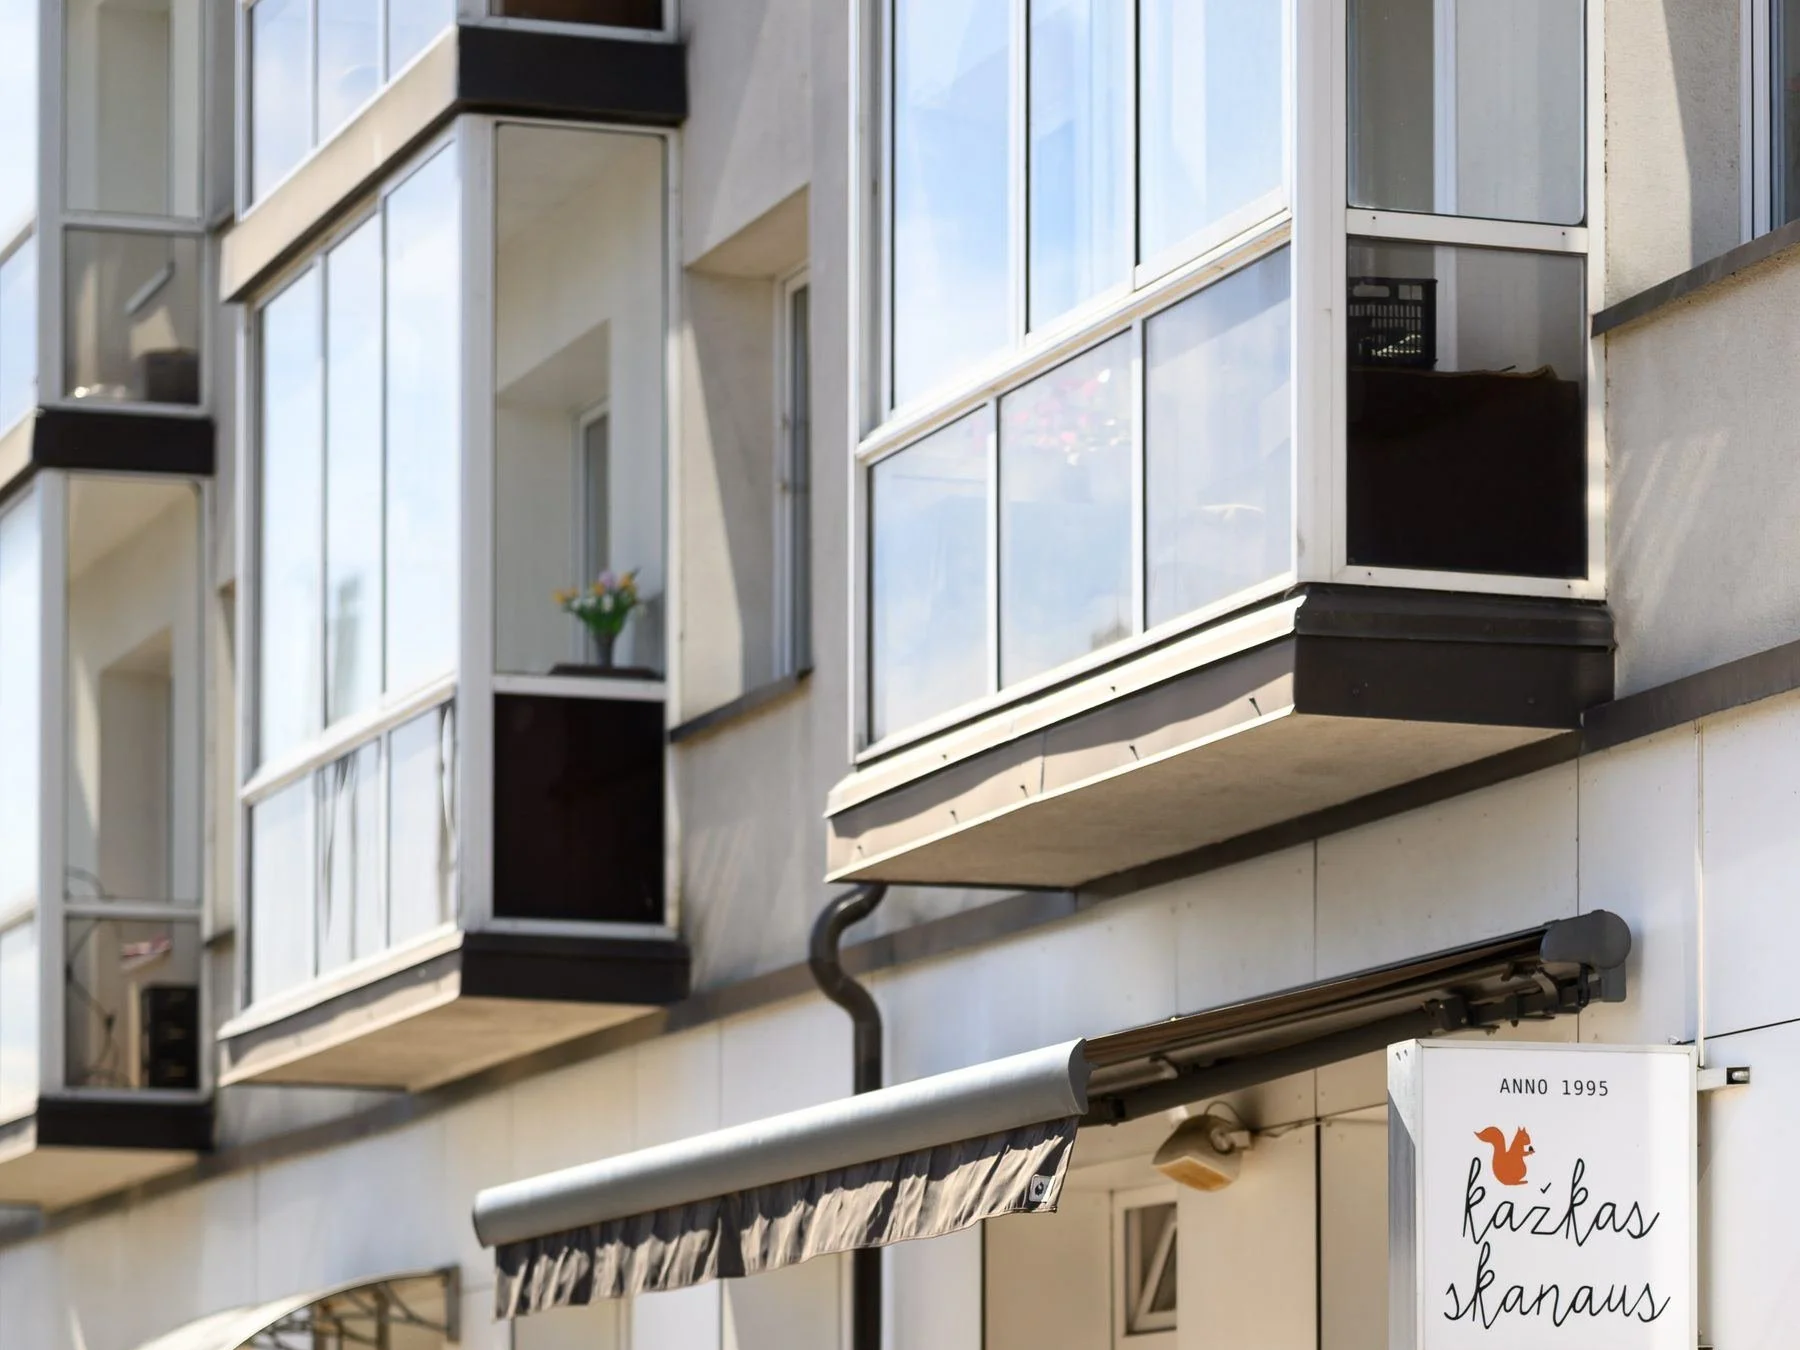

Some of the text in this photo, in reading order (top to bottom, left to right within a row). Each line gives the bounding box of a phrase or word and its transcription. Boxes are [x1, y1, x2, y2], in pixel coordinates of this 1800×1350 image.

[1499, 1078, 1609, 1097] ANNO 1995
[1443, 1240, 1671, 1330] skanaus
